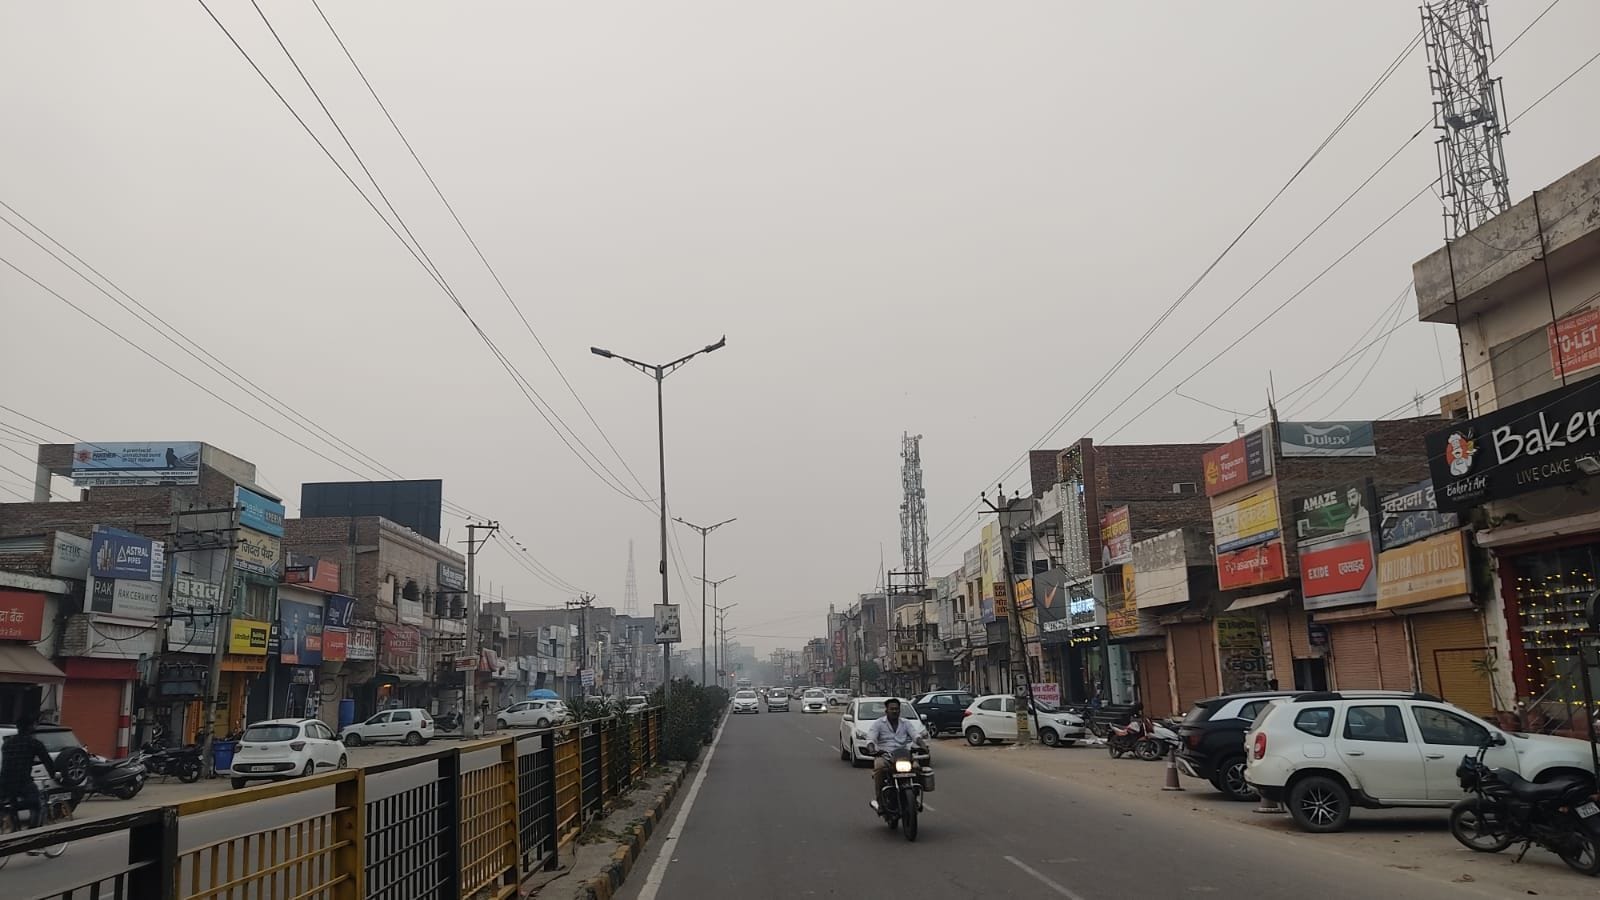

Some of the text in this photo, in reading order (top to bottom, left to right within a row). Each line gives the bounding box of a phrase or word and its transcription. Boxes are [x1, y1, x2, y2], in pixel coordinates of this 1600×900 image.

[1303, 433, 1346, 445] Dulux
[1516, 458, 1571, 485] LIVE CAKE
[1447, 479, 1473, 497] Baker's
[1303, 491, 1338, 512] AMAZE
[126, 546, 148, 557] ASTRAL
[127, 557, 142, 565] PIPES
[1380, 543, 1460, 582] KHURANA TOOLS
[1308, 565, 1329, 580] EXIDE
[94, 581, 113, 595] RAK
